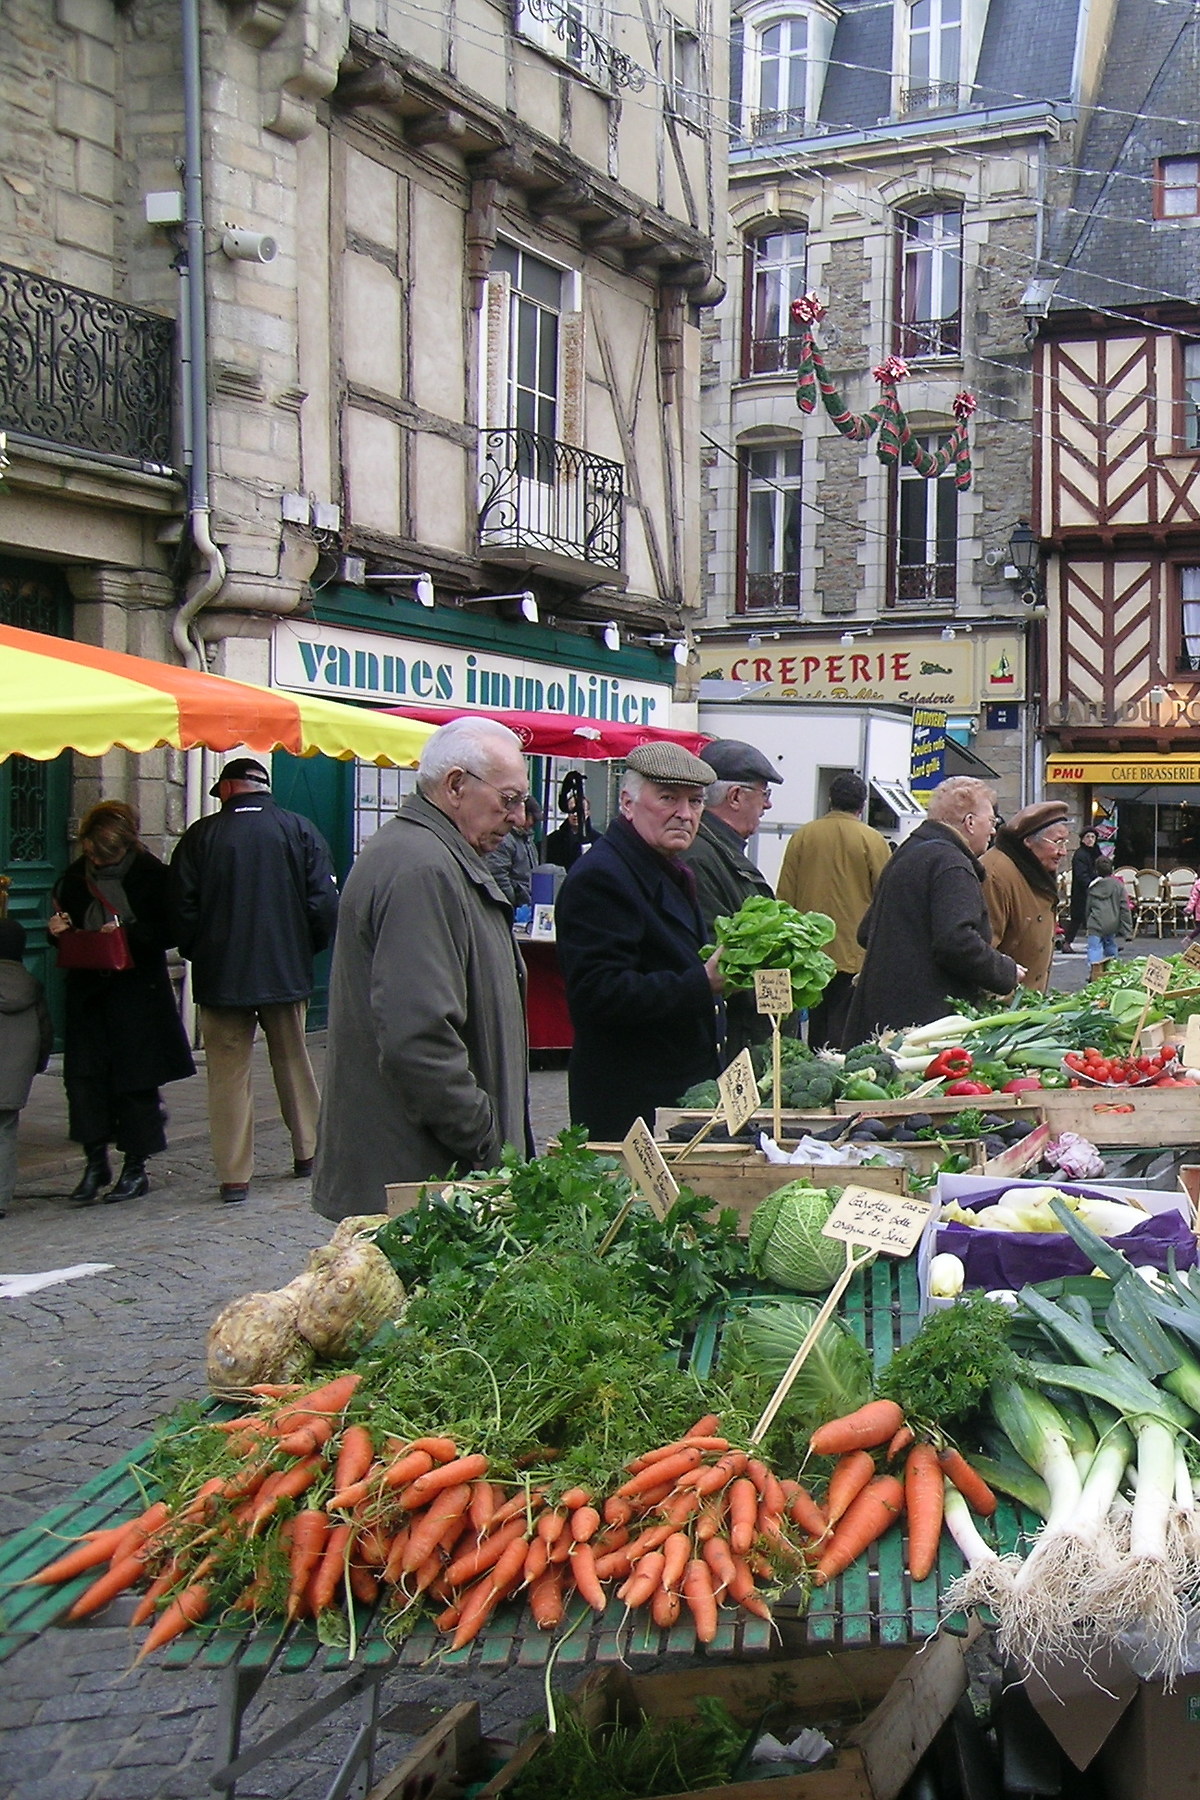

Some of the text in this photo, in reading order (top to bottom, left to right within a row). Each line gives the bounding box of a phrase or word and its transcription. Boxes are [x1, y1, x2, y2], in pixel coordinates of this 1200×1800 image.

[731, 652, 912, 684] CREPERIE
[297, 640, 656, 726] vannes immobilier
[898, 692, 955, 704] Saladerie
[1048, 700, 1107, 723] CAFE
[1121, 700, 1160, 722] DU
[1052, 768, 1084, 779] PMU
[1111, 767, 1137, 780] CAFE
[1140, 767, 1195, 780] BRASSERIE
